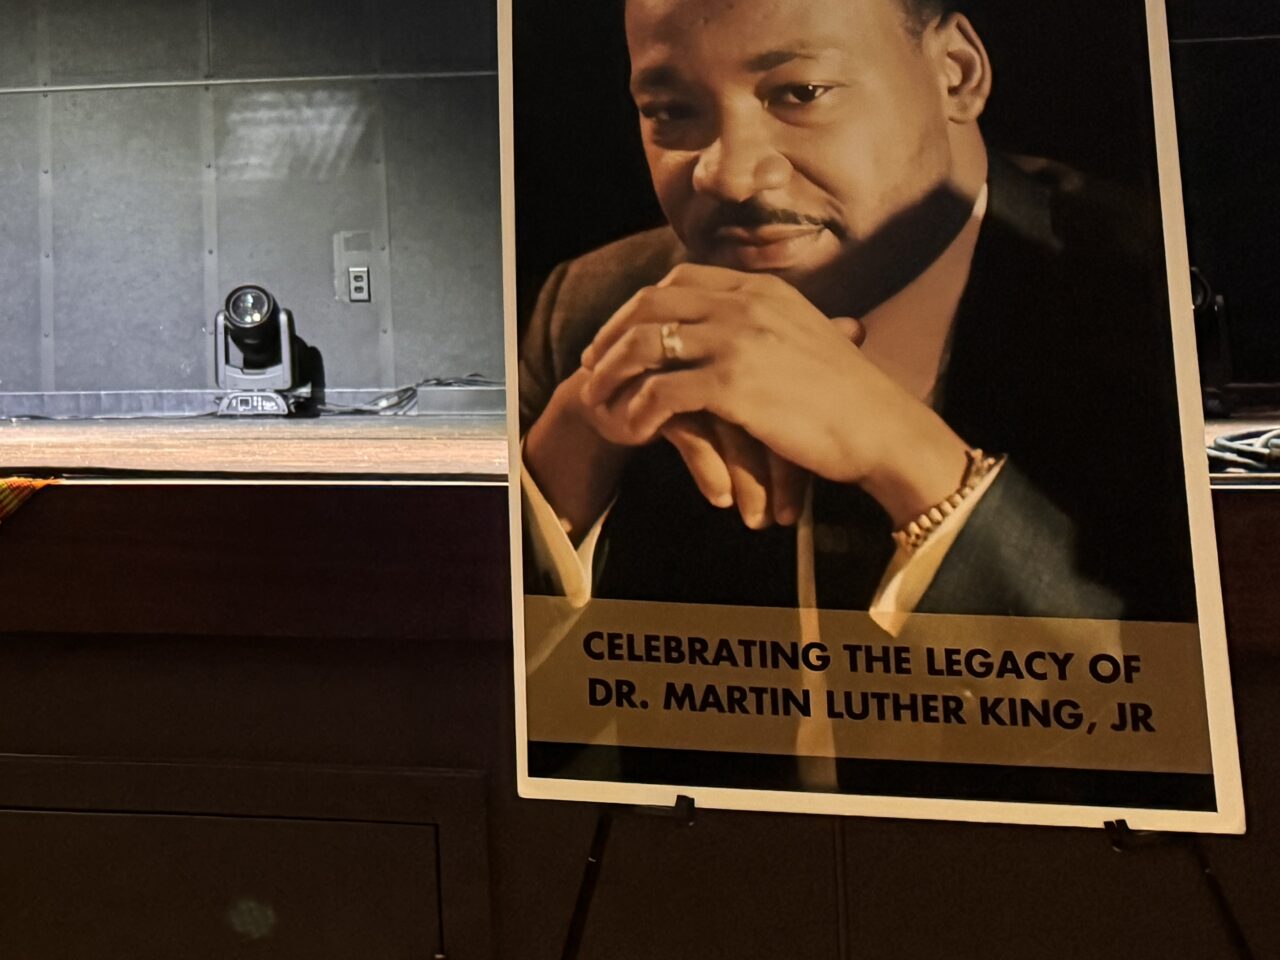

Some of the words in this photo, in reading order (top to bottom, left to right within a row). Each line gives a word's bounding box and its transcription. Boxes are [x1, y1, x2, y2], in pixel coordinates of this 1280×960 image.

[582, 629, 832, 672] CELEBRATING
[842, 643, 913, 675] THE
[925, 646, 1075, 682] LEGACY
[1088, 652, 1142, 685] OF
[586, 677, 649, 710] DR.
[662, 682, 813, 718] MARTIN
[825, 689, 966, 725] LUTHER
[978, 697, 1099, 736] KING,
[1110, 701, 1157, 733] JR
